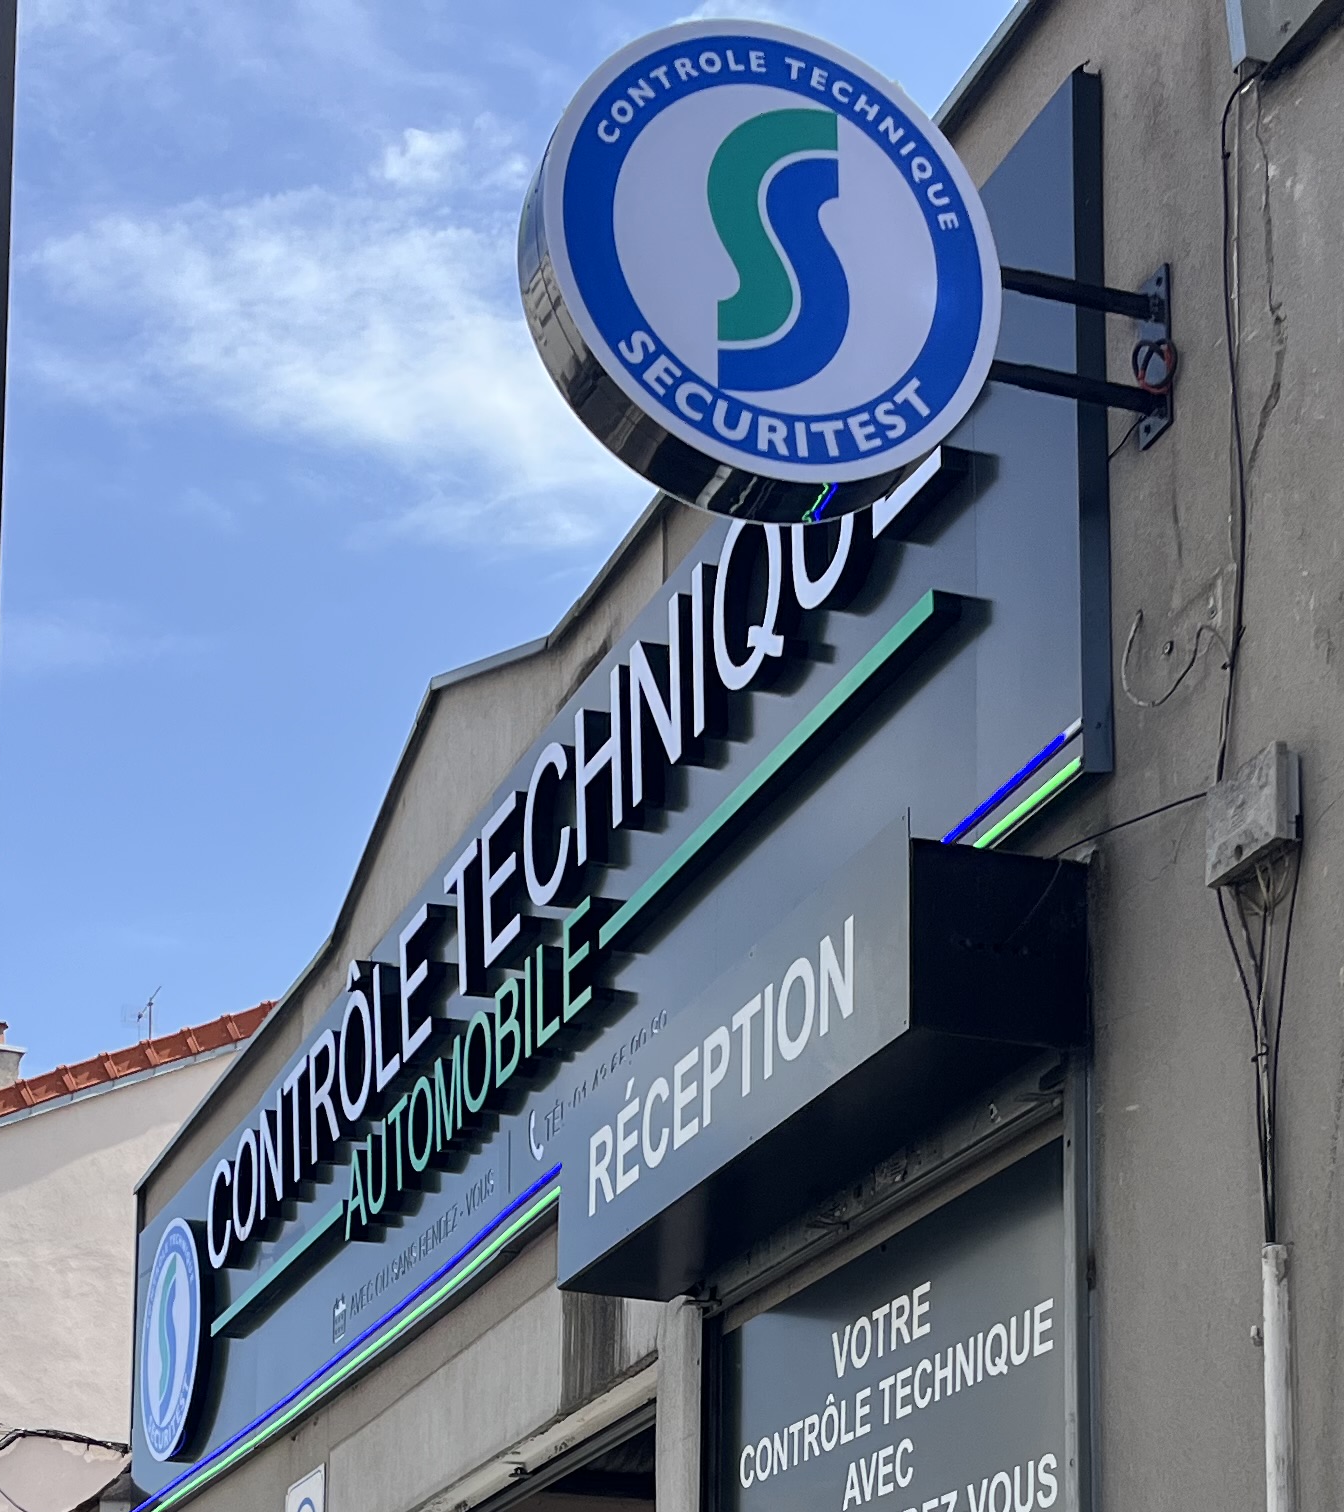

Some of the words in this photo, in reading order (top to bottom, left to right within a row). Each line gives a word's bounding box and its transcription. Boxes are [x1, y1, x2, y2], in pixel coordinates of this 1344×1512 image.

[596, 49, 766, 145] CONTROLE
[784, 55, 960, 231] TECHNIQUE
[617, 329, 932, 459] SECURITEST
[207, 904, 433, 1269] CONTRÔLE
[444, 446, 942, 997] TECHNIQU
[344, 895, 592, 1242] AUTOMOBILE
[588, 914, 854, 1217] RÉCEPTION
[350, 1279, 374, 1320] AVEC
[391, 1241, 417, 1284] SANS
[831, 1281, 931, 1378] VOTRE
[739, 1387, 871, 1489] CONTRÔLE
[878, 1298, 1054, 1425] TECHNIQUE
[842, 1438, 914, 1511] AVEC
